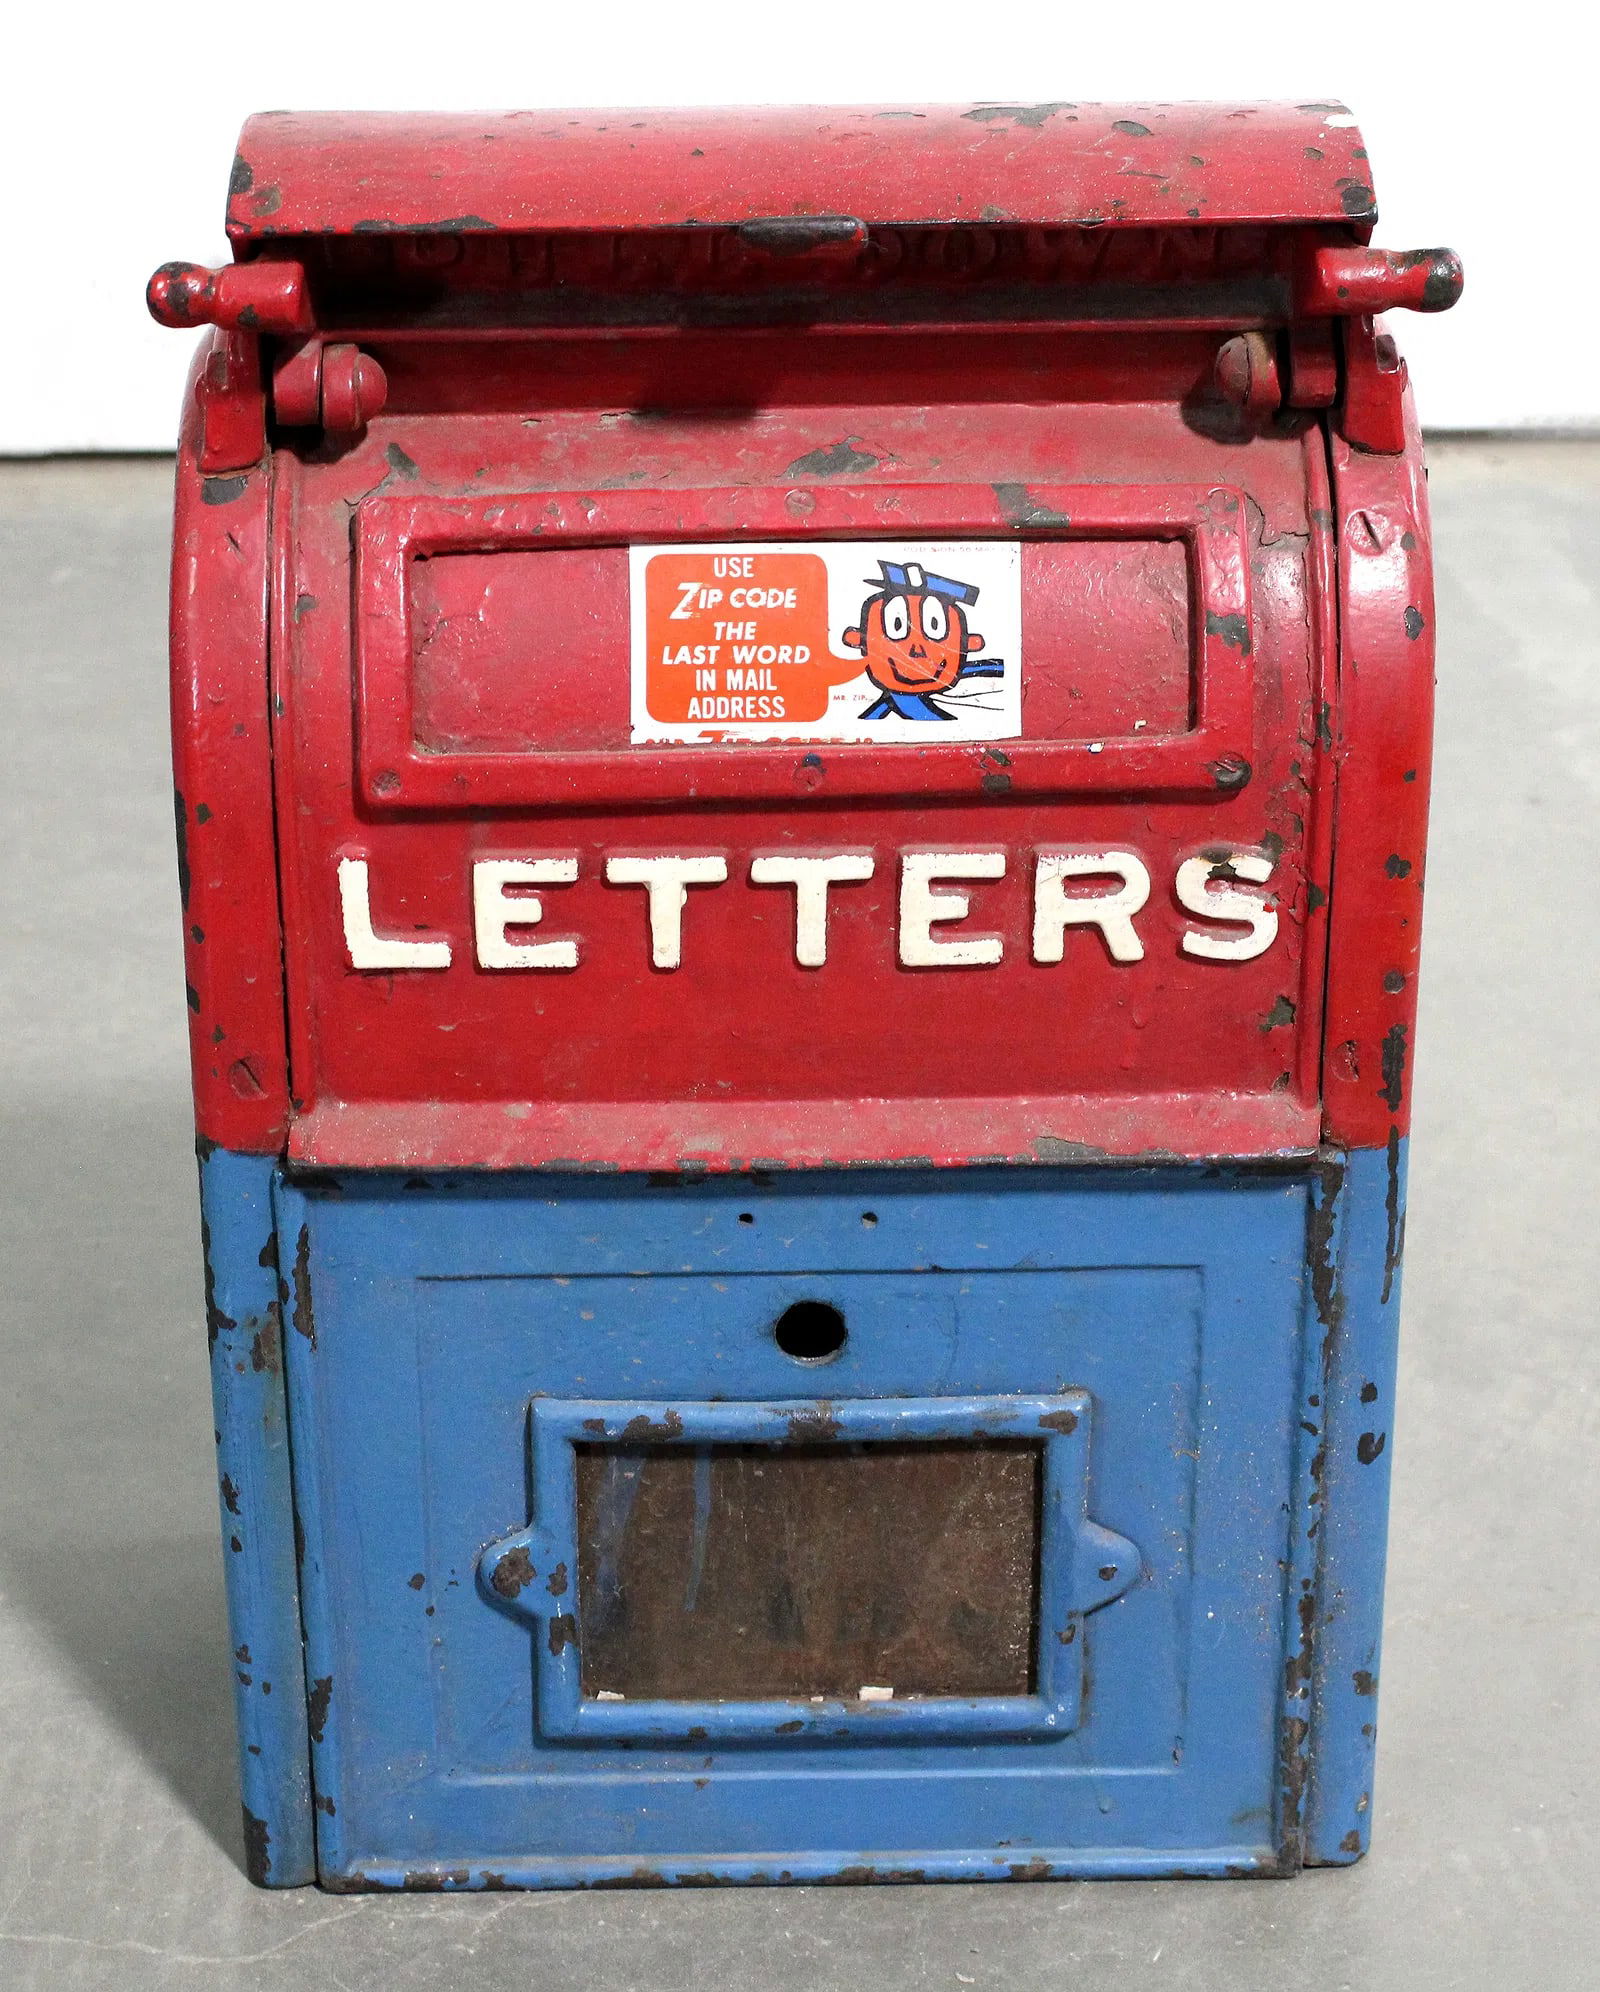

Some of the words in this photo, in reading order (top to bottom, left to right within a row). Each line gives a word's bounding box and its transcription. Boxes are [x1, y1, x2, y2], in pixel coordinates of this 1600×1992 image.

[713, 556, 754, 578] USE
[669, 582, 722, 619] ZIP
[729, 587, 797, 609] CODE
[713, 621, 756, 641] THE
[662, 645, 720, 665] LAST
[732, 645, 811, 665] WORD
[695, 669, 717, 691] IN
[726, 669, 777, 691] MAIL
[687, 696, 785, 719] ADDRESS
[336, 854, 1280, 971] LETTERS
